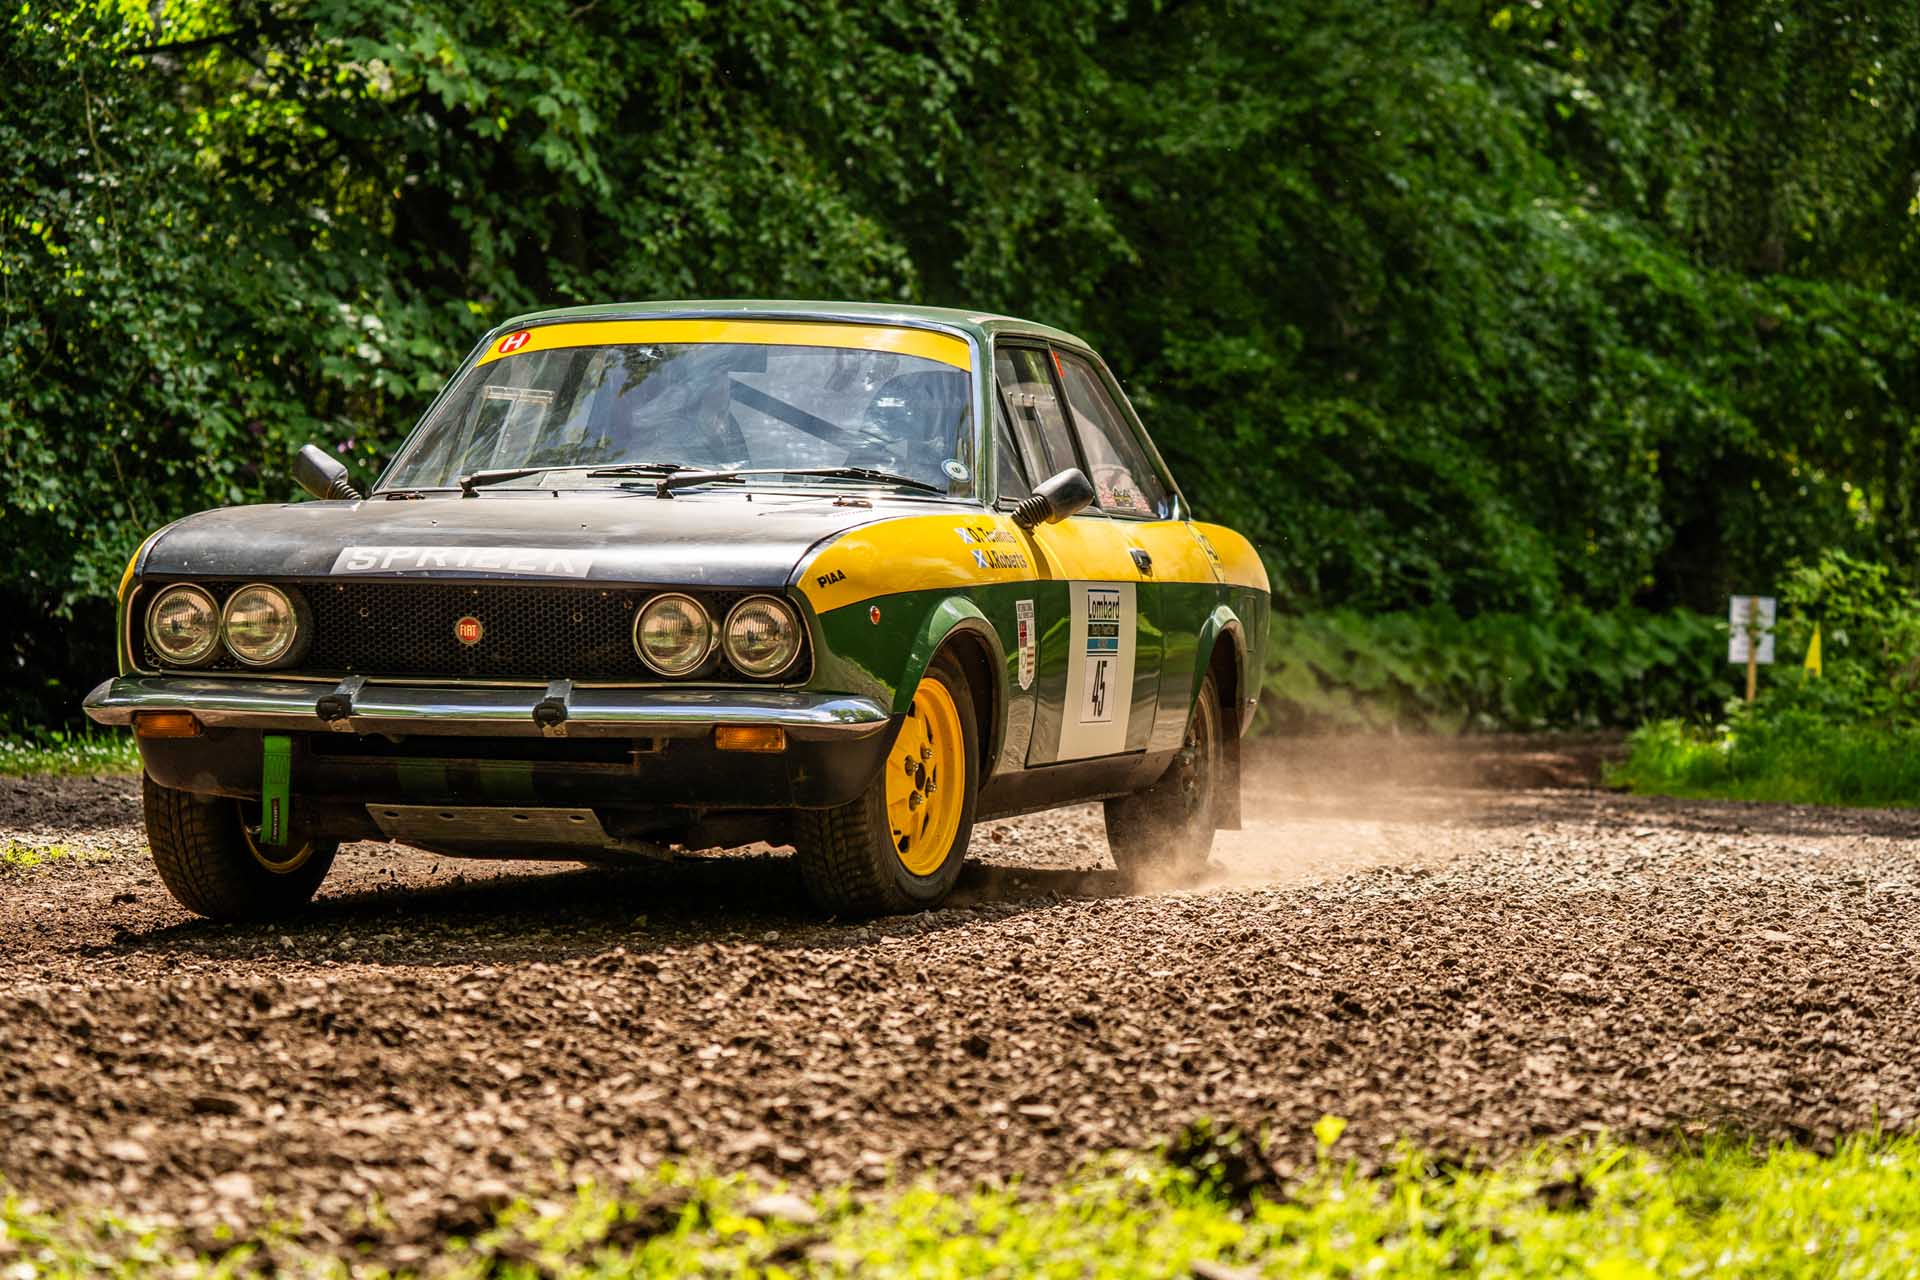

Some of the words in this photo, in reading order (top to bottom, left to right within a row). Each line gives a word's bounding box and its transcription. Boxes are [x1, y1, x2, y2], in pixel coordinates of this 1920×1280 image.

[501, 332, 528, 352] H
[816, 569, 847, 588] PIAA
[1087, 594, 1120, 619] Lombard
[459, 624, 478, 637] FIAT
[1092, 660, 1107, 718] 45
